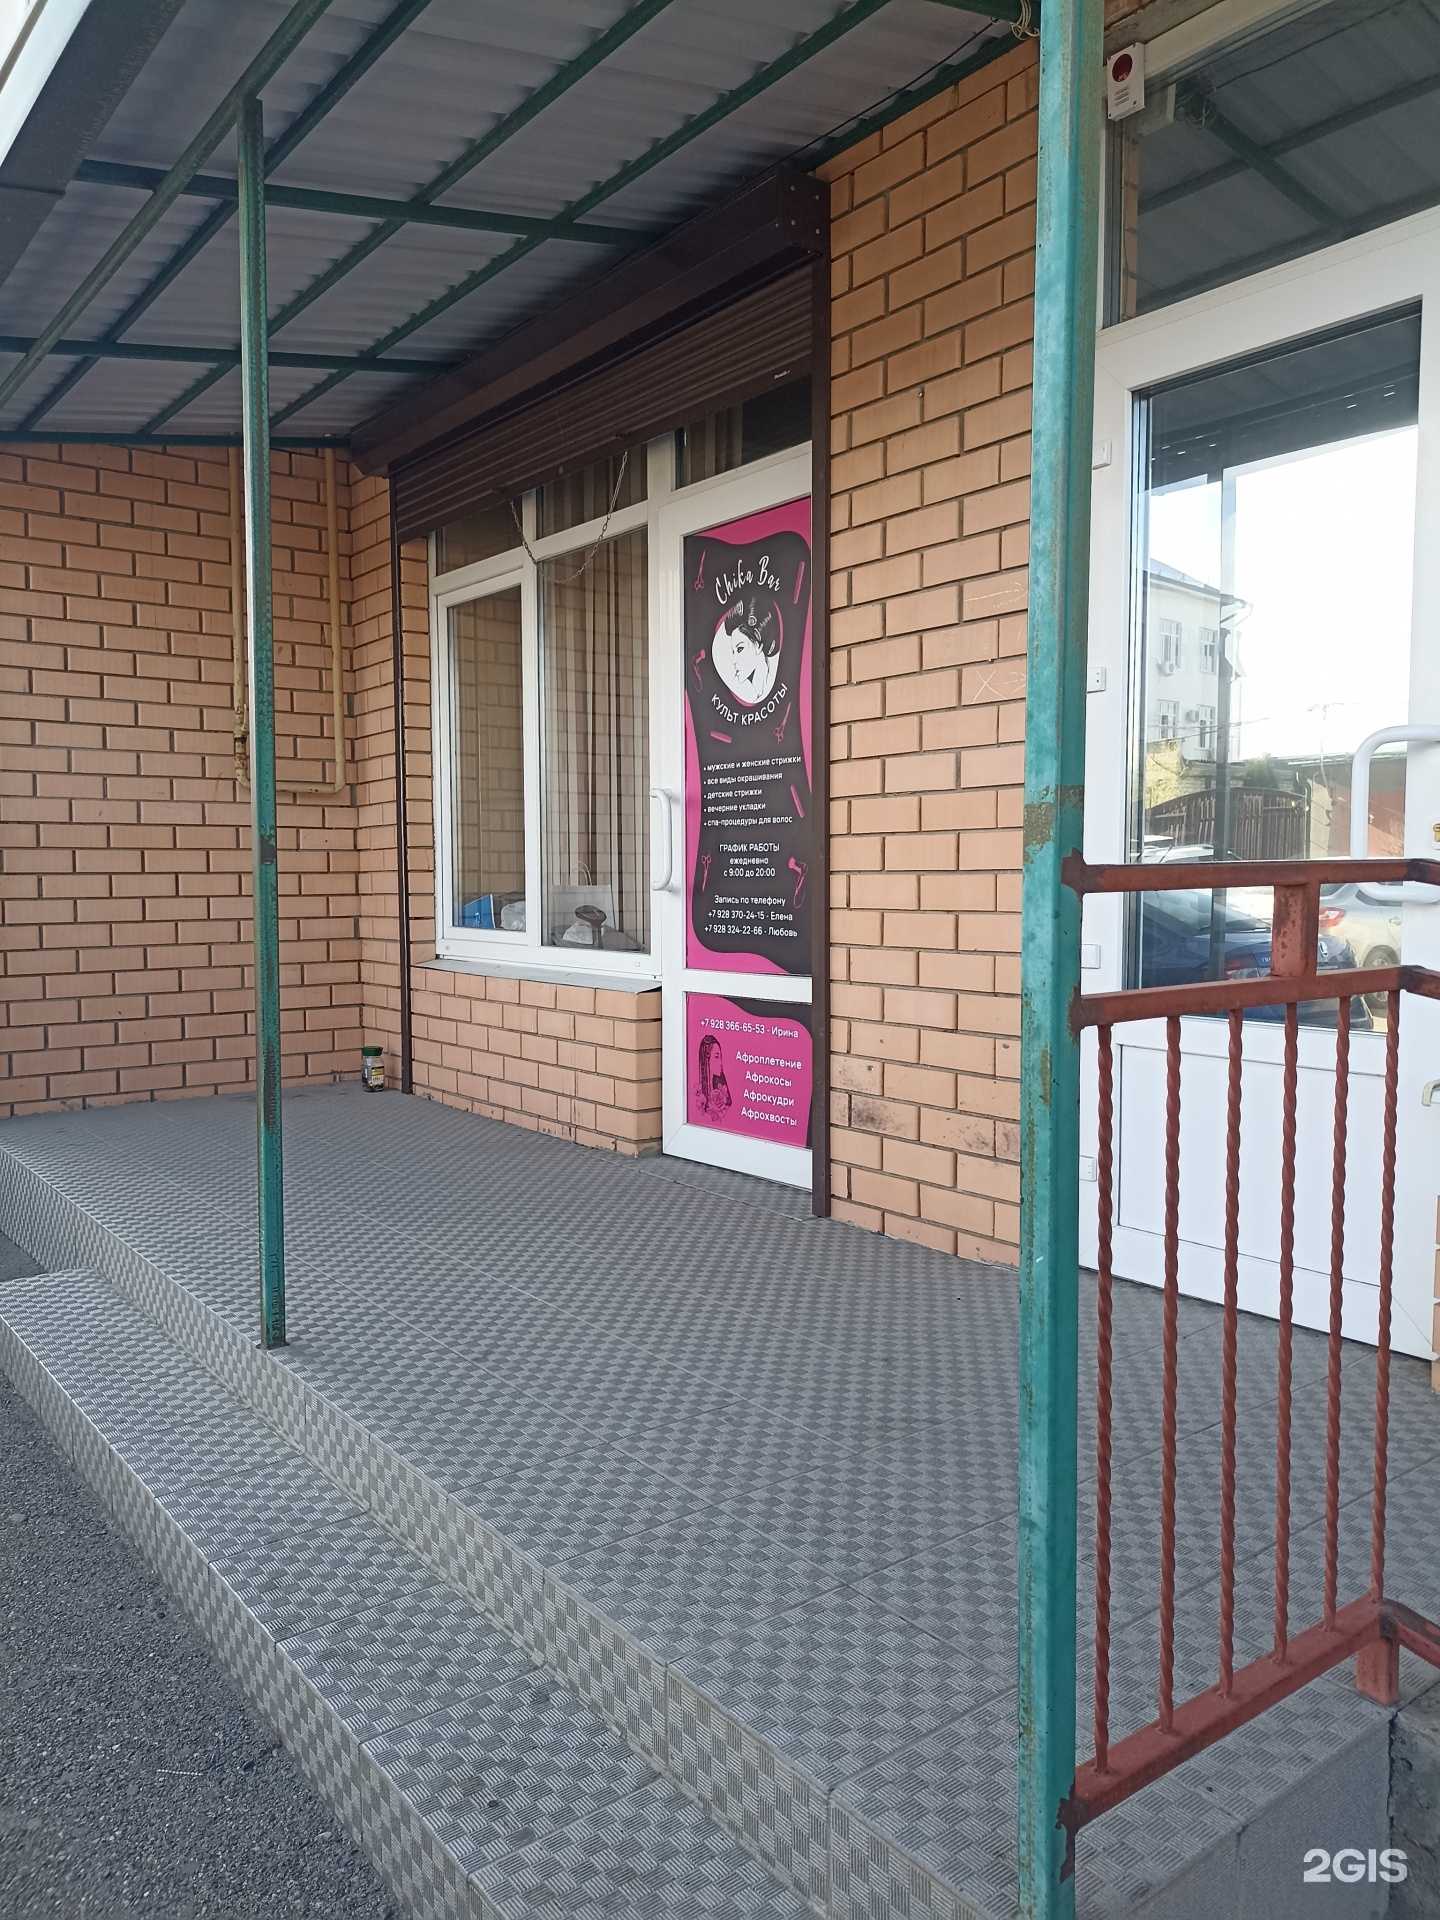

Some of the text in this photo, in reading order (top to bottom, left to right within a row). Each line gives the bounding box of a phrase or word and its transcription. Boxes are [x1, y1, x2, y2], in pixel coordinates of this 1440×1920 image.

[715, 555, 780, 604] Chika Bar
[711, 682, 788, 726] КУЛЬТ КРАСОТЫ
[707, 763, 735, 772] мужские
[741, 759, 770, 768] женские
[771, 756, 801, 765] стрижки
[707, 773, 783, 785] все виды окрашивания
[707, 789, 762, 800] детские стрижки
[707, 803, 766, 813] вечерние укладки
[707, 818, 757, 827] спа-процедуры
[758, 817, 771, 825] для
[719, 843, 780, 852] ГРАФИК РАБОТЫ
[728, 868, 744, 876] 9:00
[755, 868, 776, 877] 20:00
[714, 895, 740, 904] Запись
[751, 897, 786, 906] телефону
[716, 910, 730, 919] 928
[731, 911, 765, 920] 370-24-15
[770, 912, 793, 921] Елена
[713, 925, 726, 933] 928
[727, 925, 763, 935] 324-22-66
[768, 927, 798, 937] Любовь
[710, 1019, 725, 1030] 928
[771, 1026, 799, 1038] Ирина
[735, 1051, 802, 1070] Афроплетение
[745, 1071, 792, 1087] Афрокосы
[743, 1089, 795, 1107] Афрокудри
[740, 1107, 797, 1126] Афрохвосты
